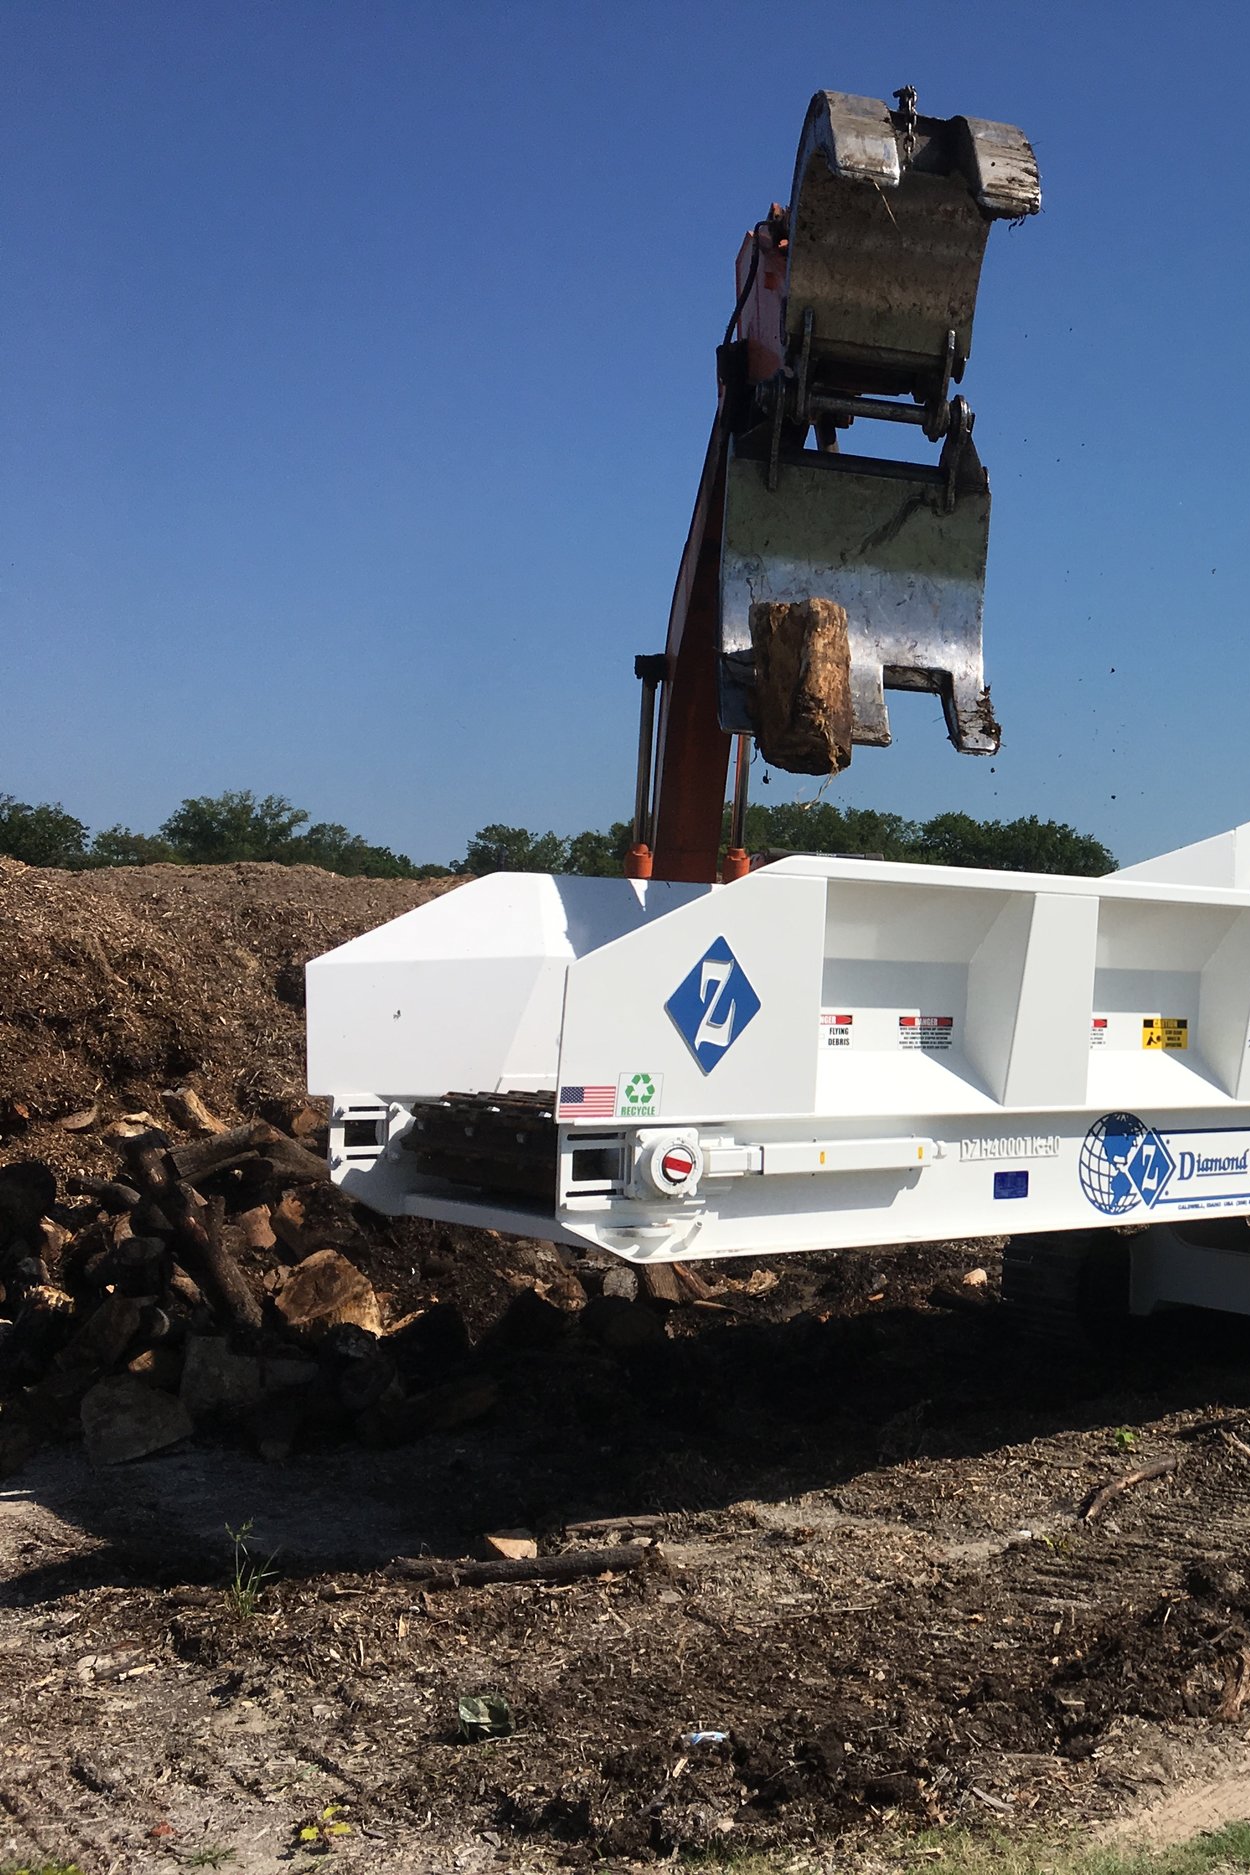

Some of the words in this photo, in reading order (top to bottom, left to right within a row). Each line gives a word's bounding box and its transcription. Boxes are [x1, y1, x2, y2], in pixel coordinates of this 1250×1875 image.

[694, 958, 736, 1051] Z
[915, 1018, 938, 1026] DANGER
[829, 1027, 849, 1035] FLYING
[828, 1038, 850, 1046] DEBRIS
[620, 1105, 656, 1116] RECYCLE
[1177, 1149, 1250, 1181] Diamond
